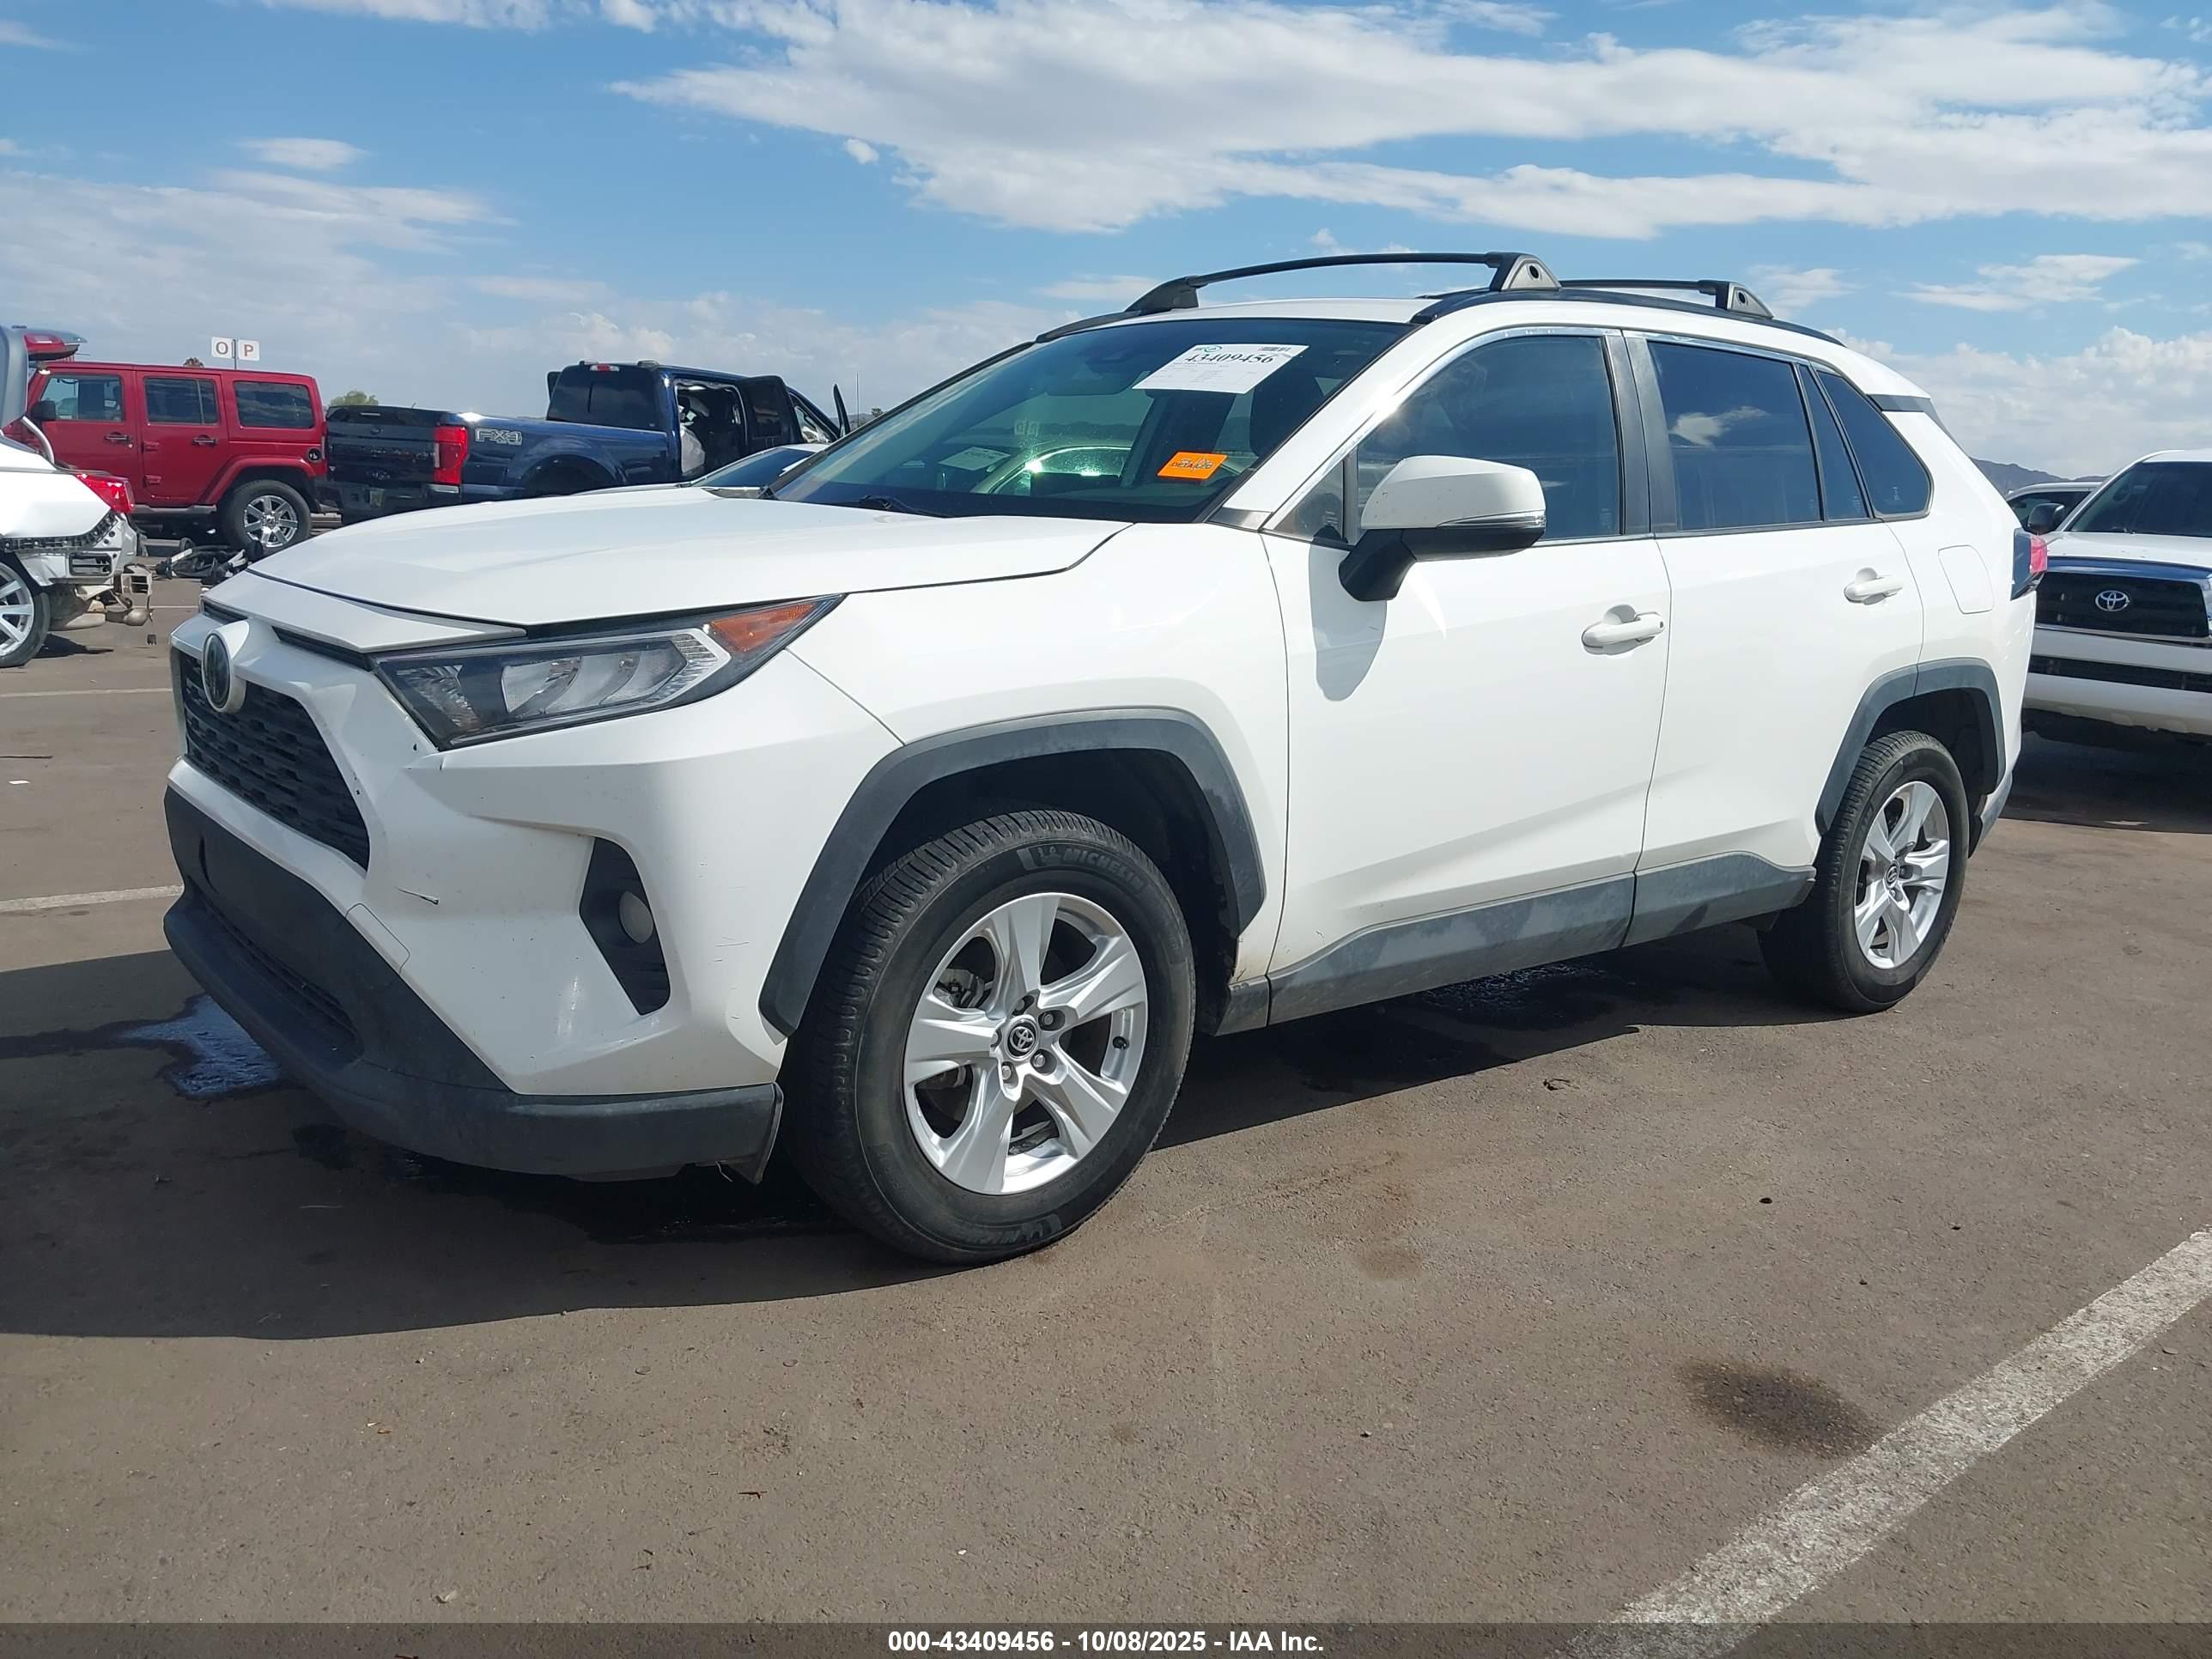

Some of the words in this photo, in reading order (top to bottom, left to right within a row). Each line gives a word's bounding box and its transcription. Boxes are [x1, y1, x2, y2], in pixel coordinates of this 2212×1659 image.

[216, 341, 228, 355] O
[244, 343, 254, 356] P
[1184, 352, 1276, 363] 43409456
[475, 428, 522, 444] FX4
[1062, 848, 1144, 891] MICHELIN
